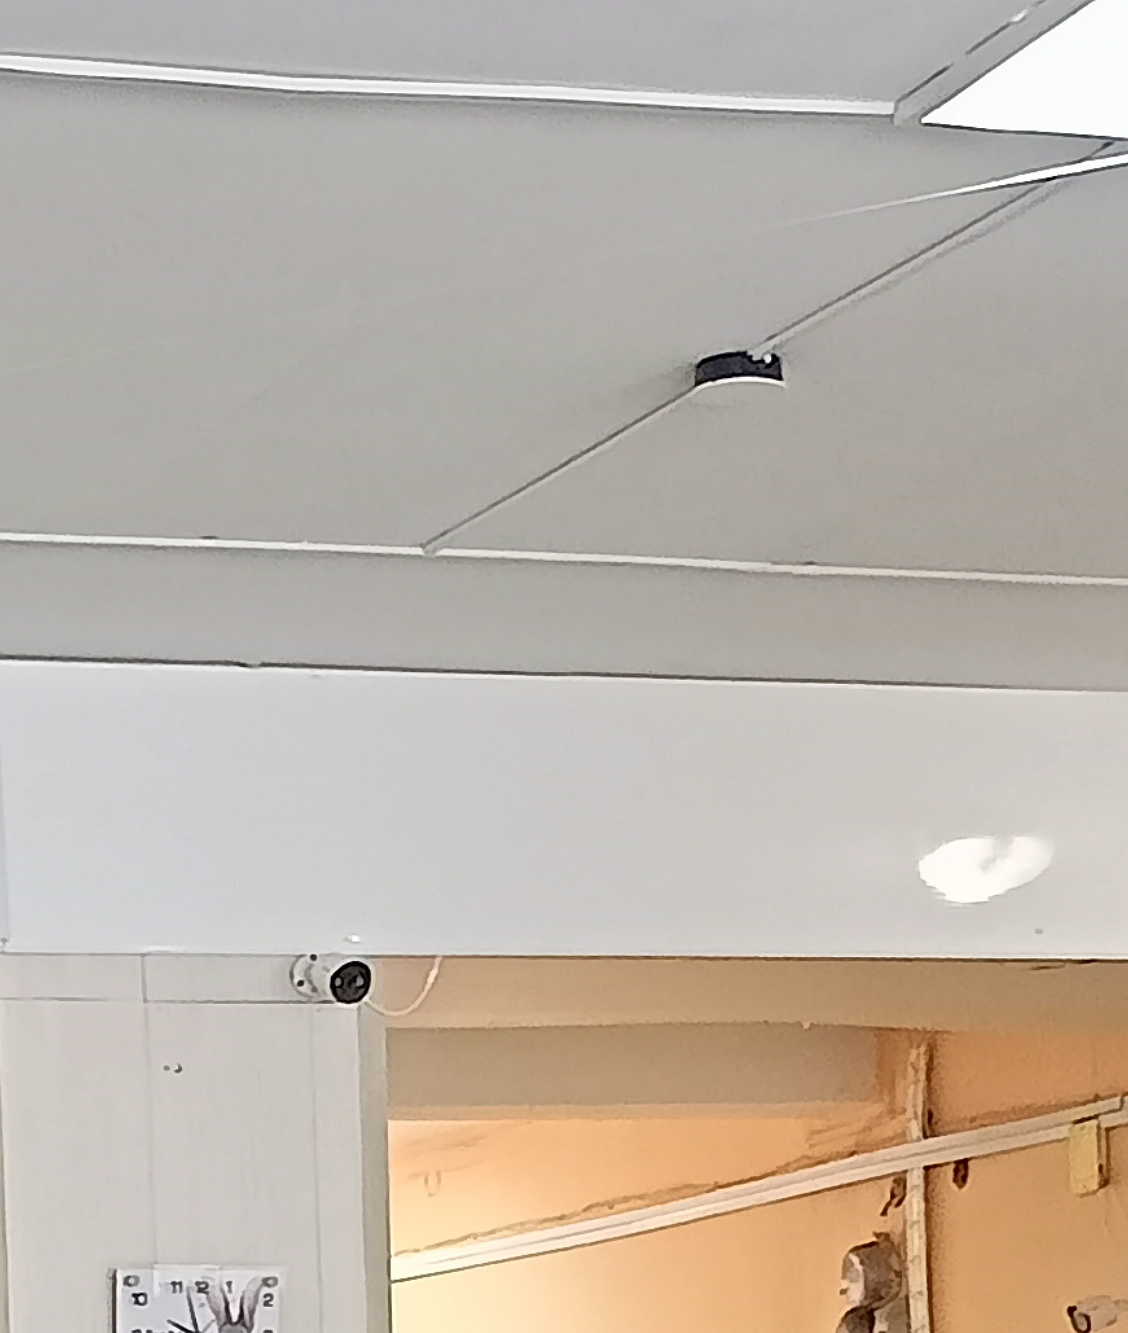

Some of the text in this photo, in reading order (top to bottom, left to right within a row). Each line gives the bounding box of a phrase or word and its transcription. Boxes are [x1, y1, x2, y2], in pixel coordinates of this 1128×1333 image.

[171, 1280, 183, 1294] 11
[195, 1281, 209, 1295] 12
[226, 1281, 233, 1294] 1
[263, 1293, 274, 1308] 2
